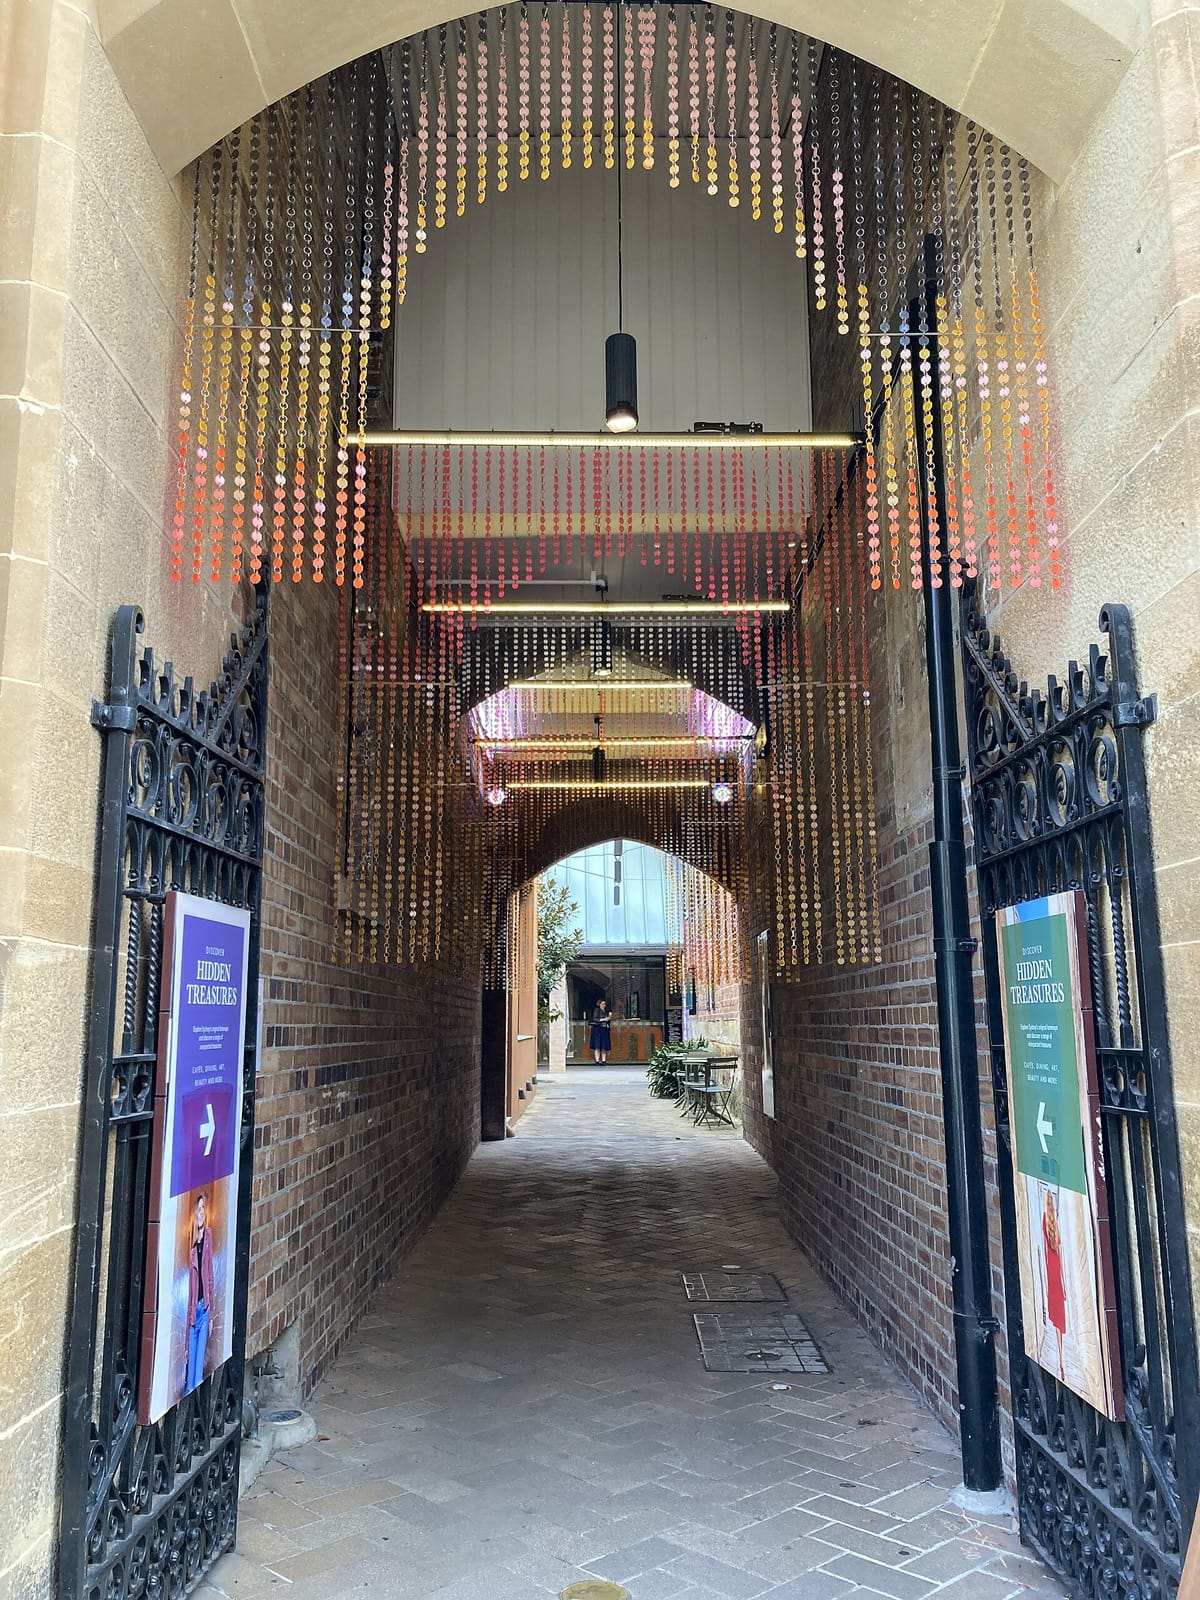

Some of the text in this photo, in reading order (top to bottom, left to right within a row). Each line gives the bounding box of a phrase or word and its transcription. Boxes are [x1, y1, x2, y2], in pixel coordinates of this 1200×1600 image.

[205, 945, 225, 957] DISCOVER
[1022, 945, 1042, 956] DISCOVER
[196, 960, 232, 982] HIDDEN
[1016, 958, 1052, 981] HIDDEN
[186, 984, 238, 1006] TREASURES
[1010, 982, 1065, 1005] TREASURES
